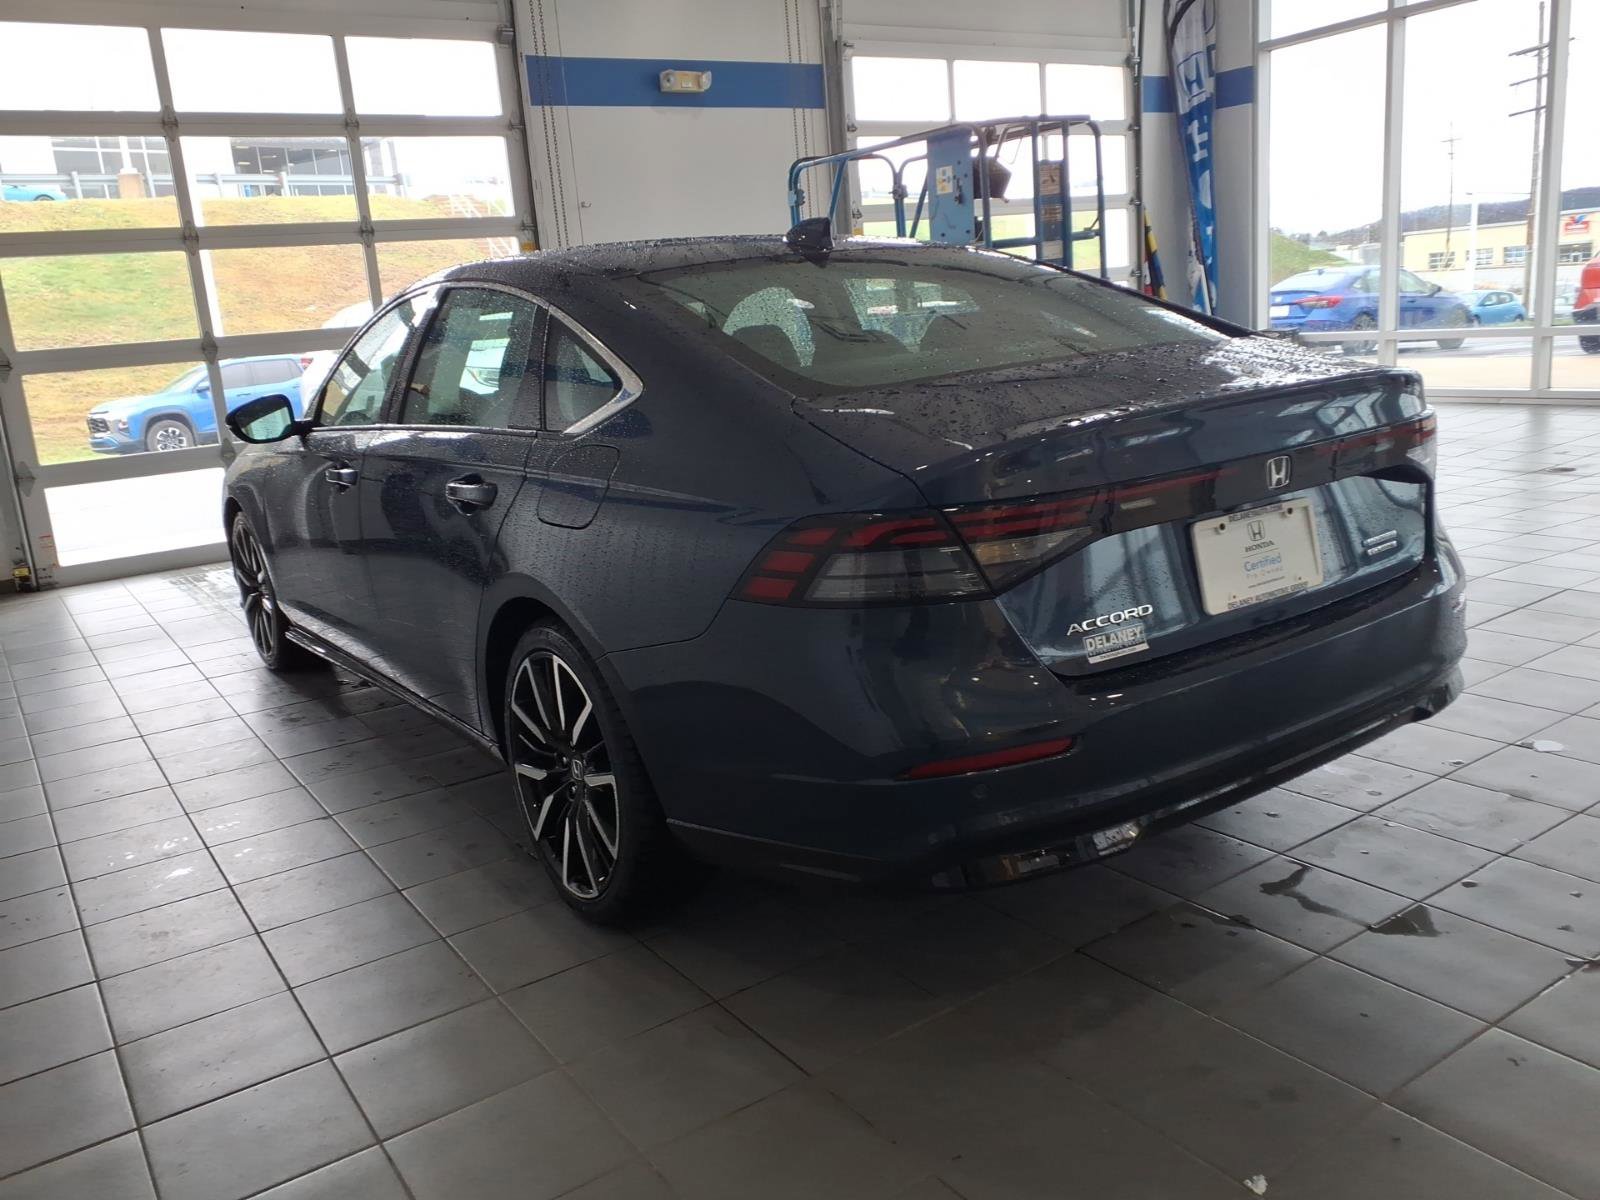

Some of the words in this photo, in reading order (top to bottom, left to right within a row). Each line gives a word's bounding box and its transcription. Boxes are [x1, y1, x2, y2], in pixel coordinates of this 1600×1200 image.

[1245, 540, 1275, 553] HONDA
[1244, 552, 1282, 572] Certified
[1066, 604, 1153, 636] ACCORD
[1086, 626, 1142, 652] DELANEY
